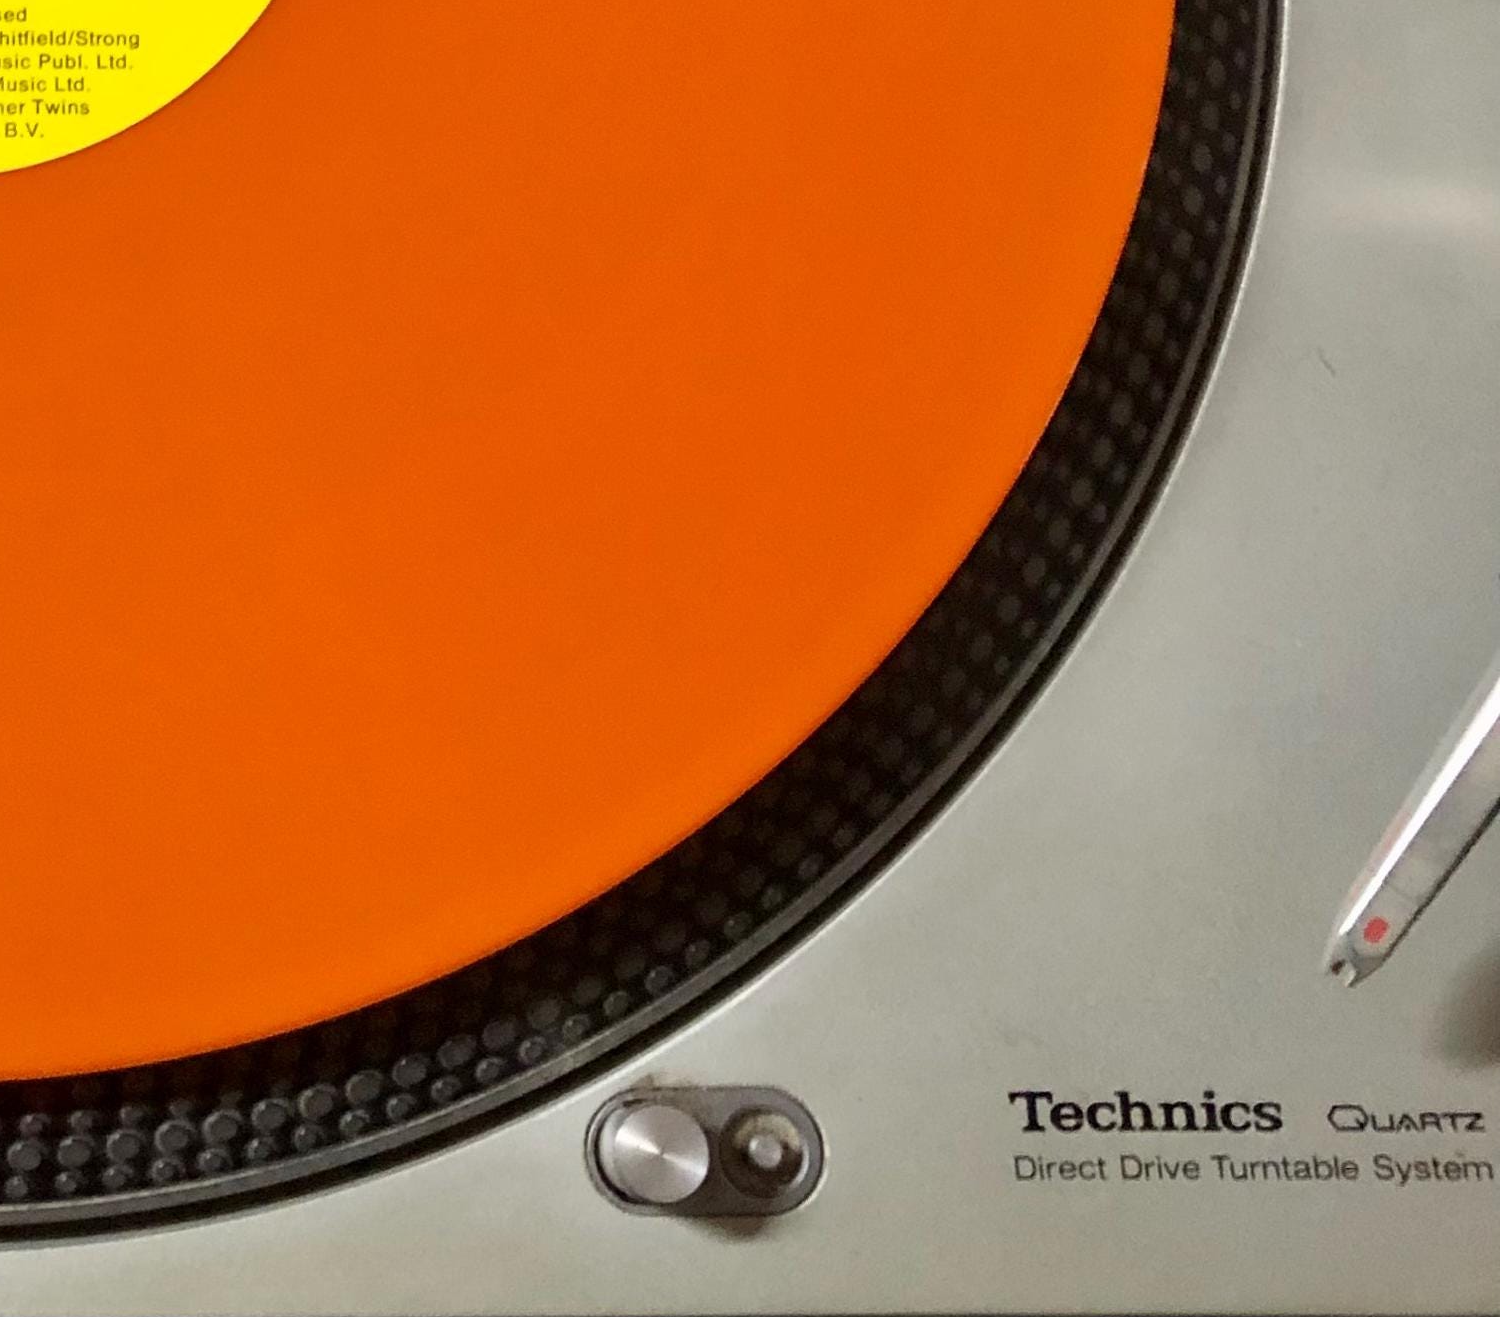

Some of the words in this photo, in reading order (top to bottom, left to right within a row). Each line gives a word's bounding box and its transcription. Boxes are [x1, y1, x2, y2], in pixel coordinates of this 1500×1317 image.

[38, 52, 89, 70] Publ.
[96, 53, 133, 71] Ltd.
[54, 75, 91, 93] Ltd.
[31, 98, 91, 116] Twins
[4, 121, 45, 139] B.V.
[1008, 1089, 1285, 1133] Technics
[1014, 1154, 1106, 1182] Direct
[1120, 1154, 1200, 1182] Drive
[1211, 1154, 1359, 1182] Turntable
[1372, 1153, 1495, 1187] System
